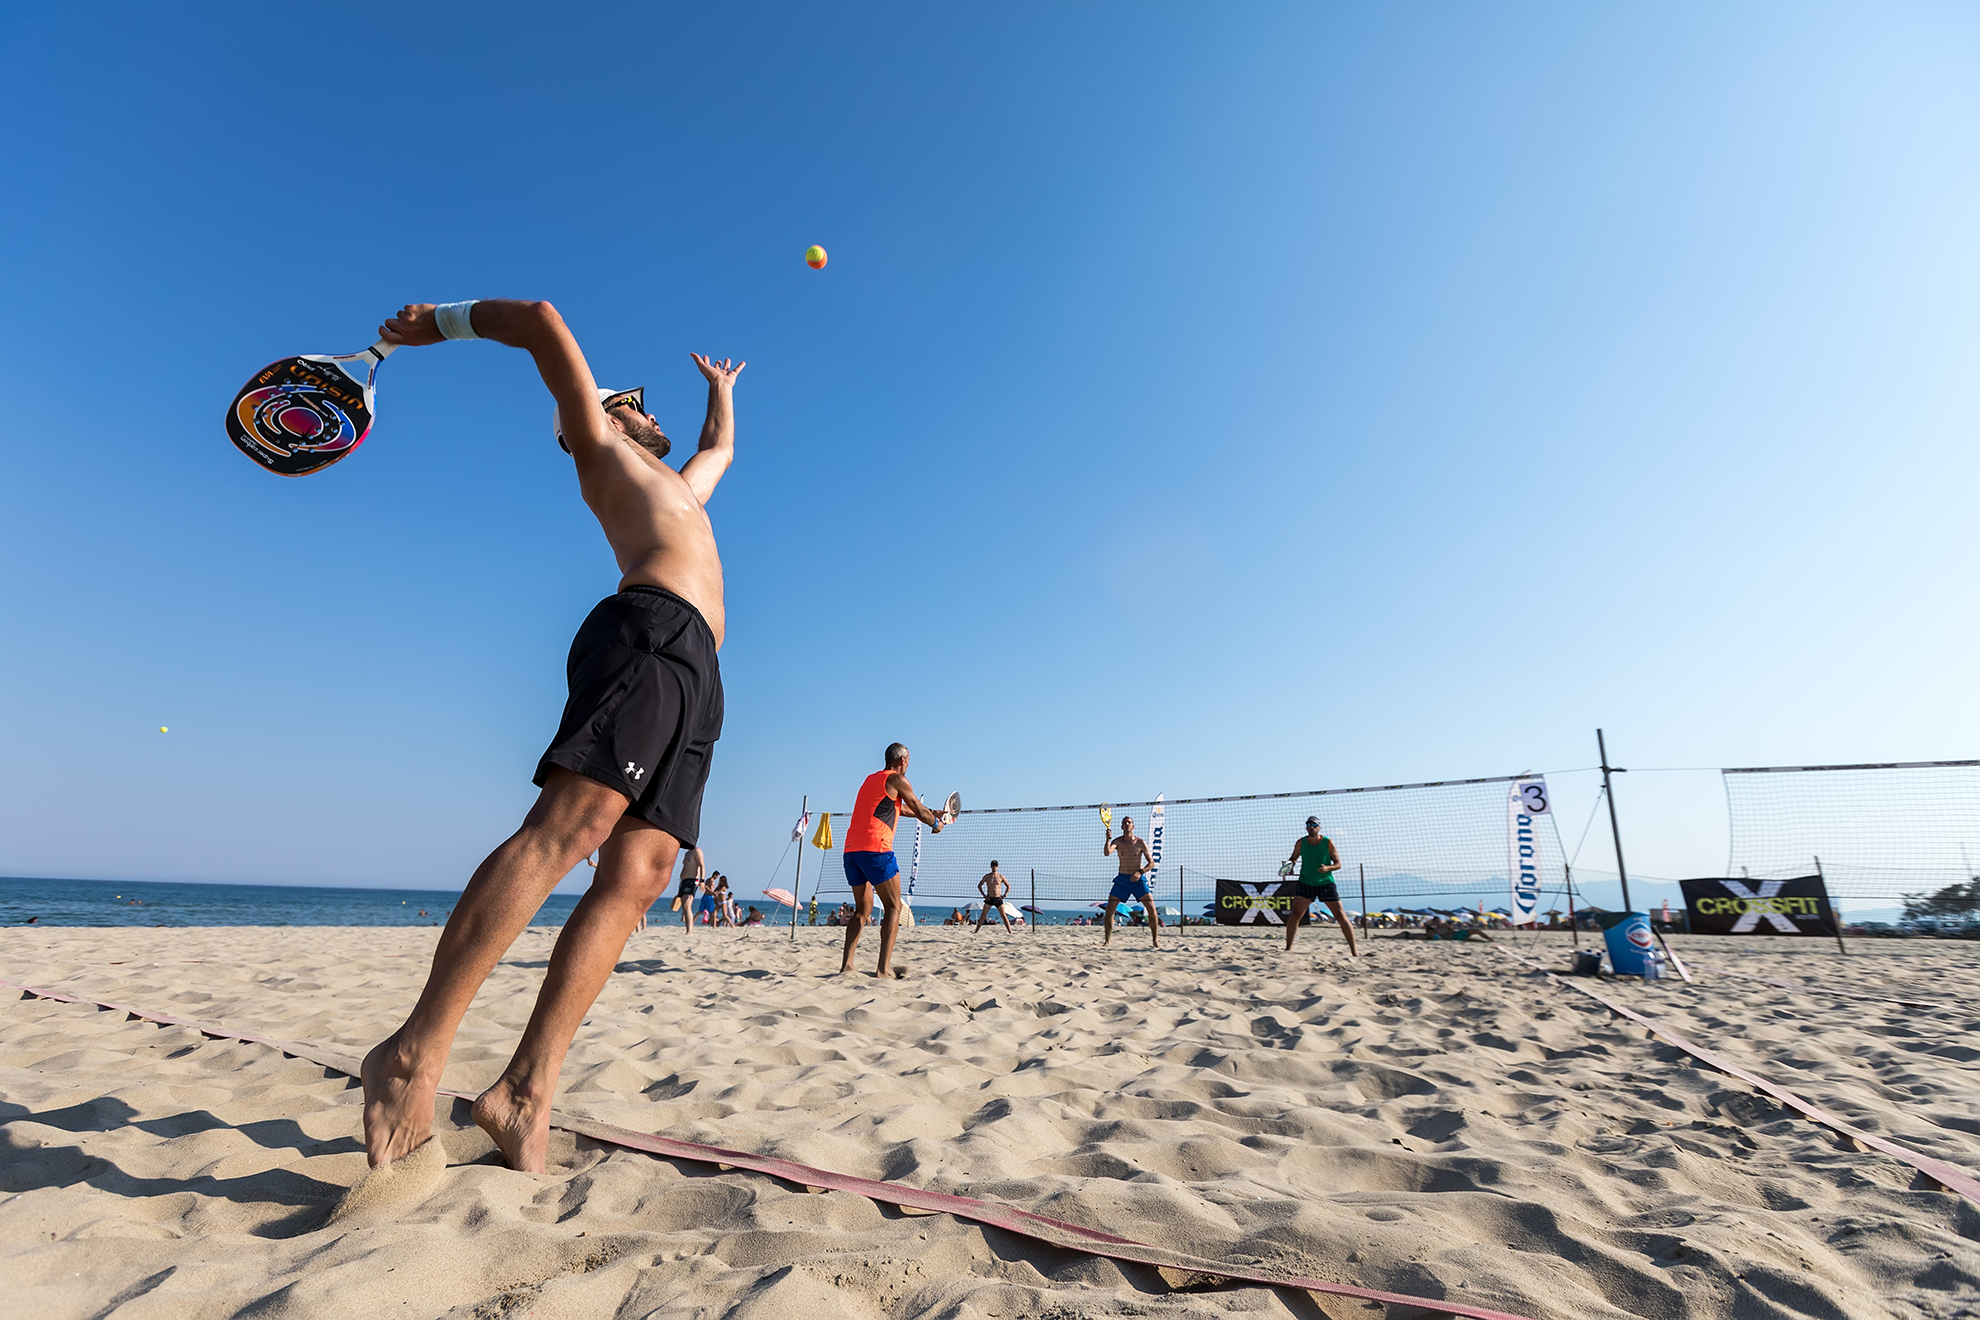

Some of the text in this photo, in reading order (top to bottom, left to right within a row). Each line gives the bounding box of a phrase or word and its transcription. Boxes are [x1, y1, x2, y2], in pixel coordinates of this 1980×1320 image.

[1524, 785, 1547, 812] 3
[1221, 895, 1295, 910] CROSSFI
[1695, 896, 1820, 915] CROSSFIT
